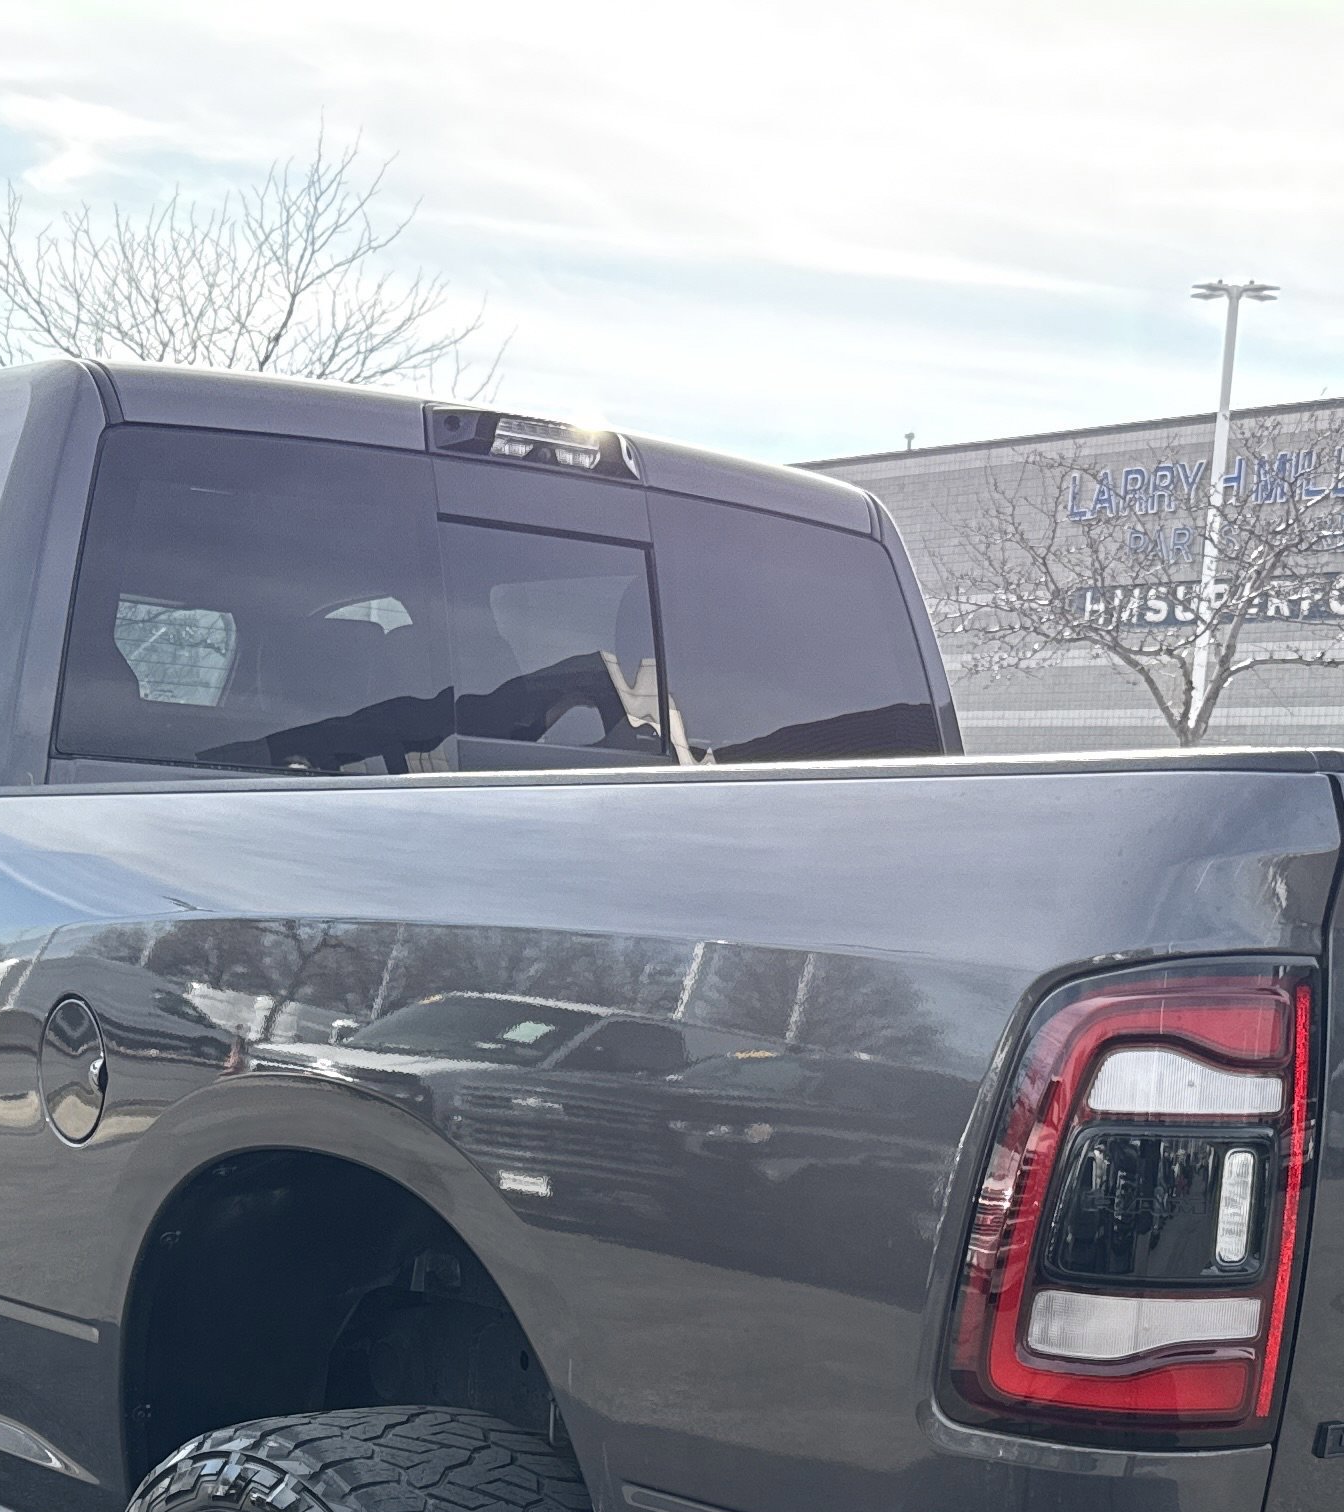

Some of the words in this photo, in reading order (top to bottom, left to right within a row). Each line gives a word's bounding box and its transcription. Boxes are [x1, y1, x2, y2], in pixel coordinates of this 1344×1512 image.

[1066, 459, 1207, 522] LARRY
[1218, 455, 1247, 503] H
[1126, 522, 1242, 563] PARS
